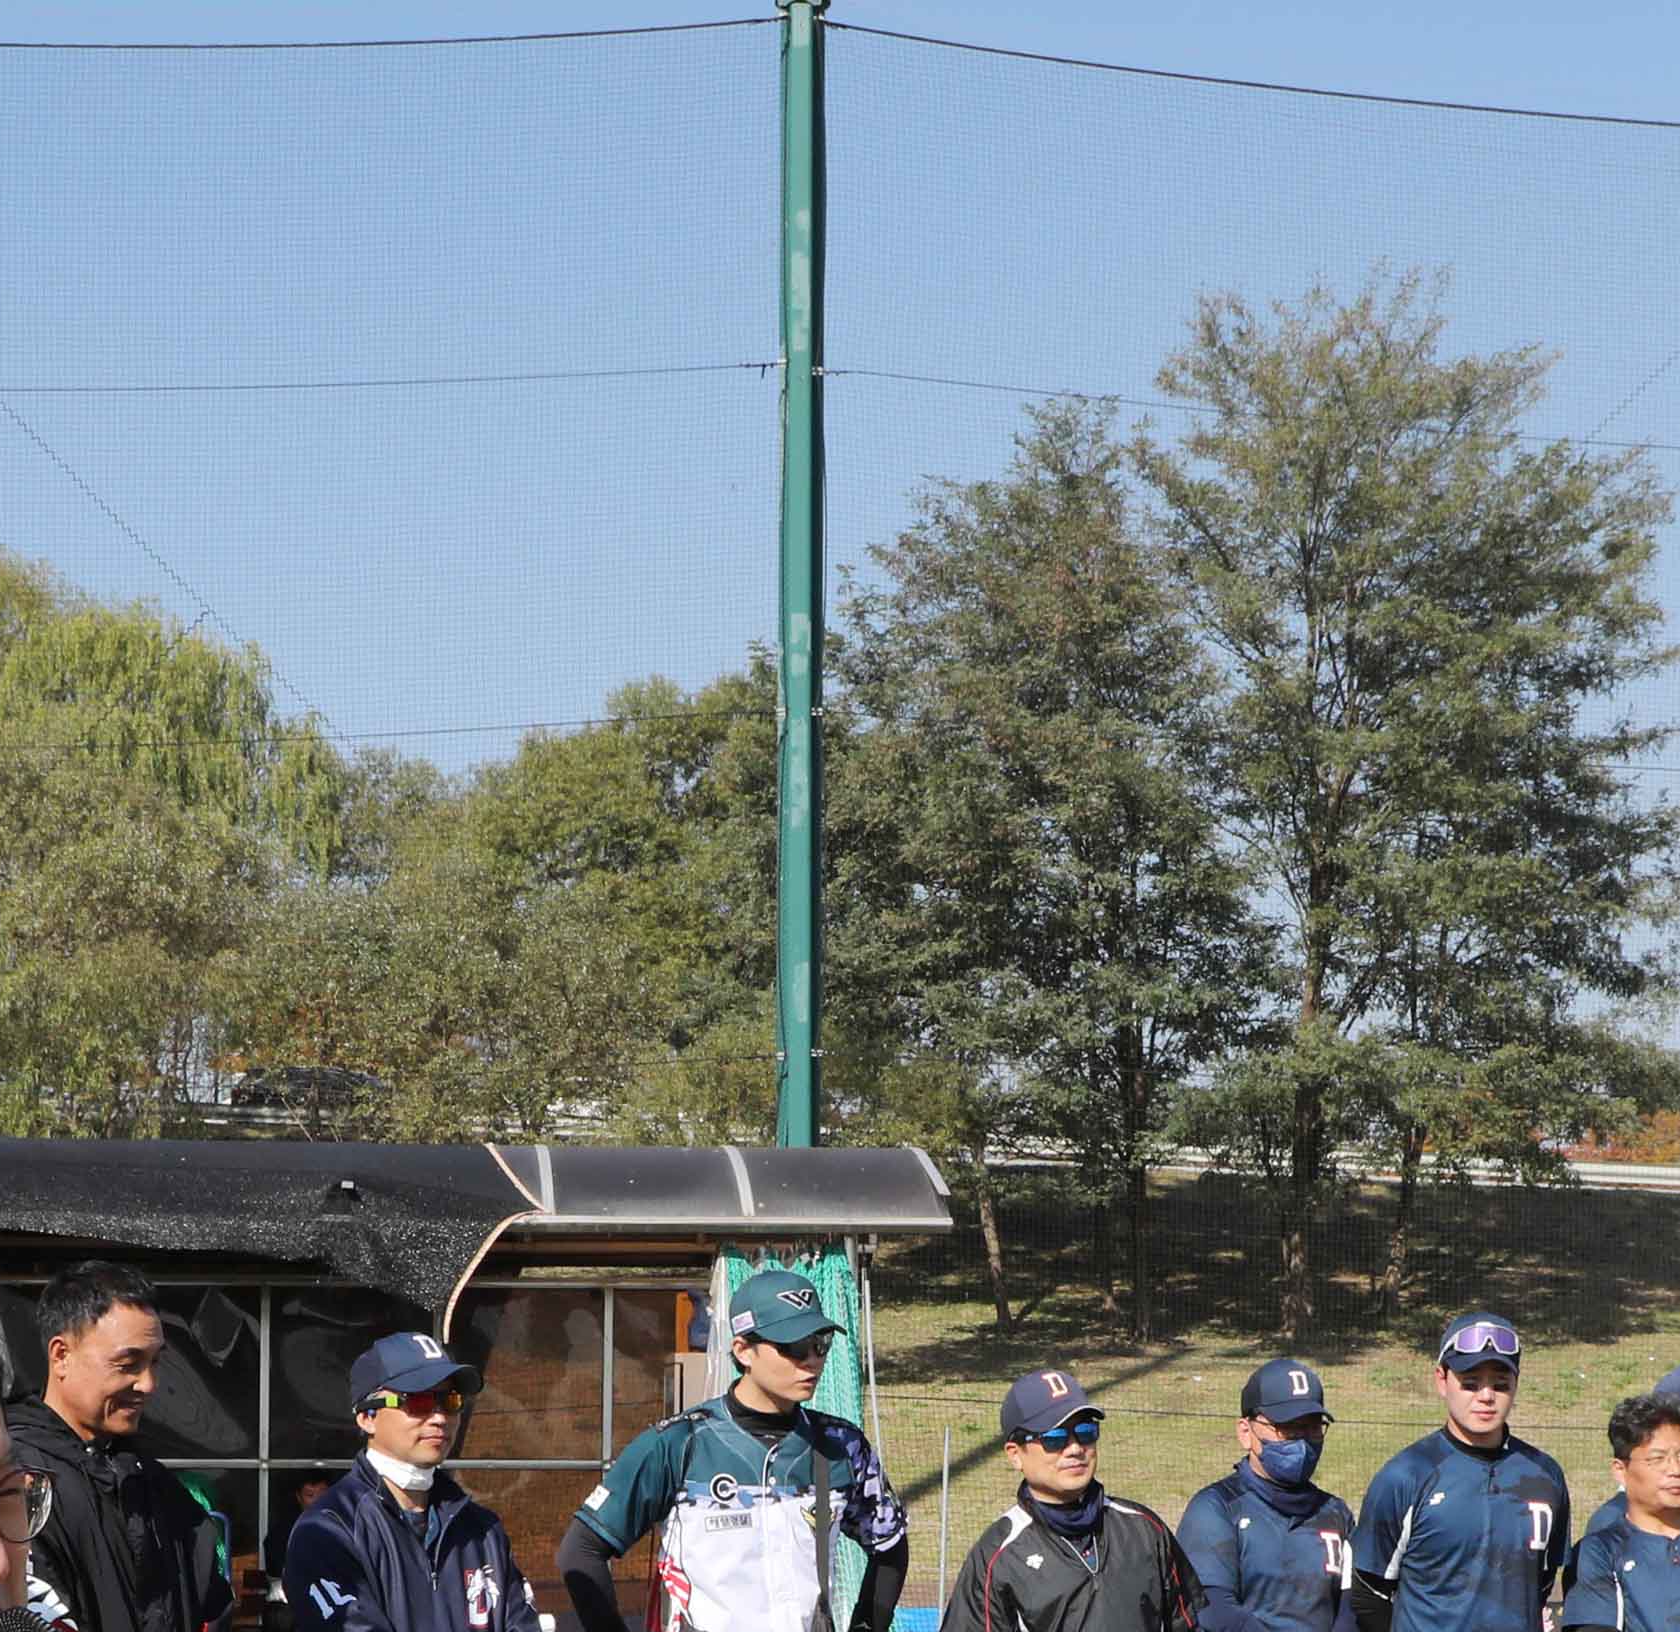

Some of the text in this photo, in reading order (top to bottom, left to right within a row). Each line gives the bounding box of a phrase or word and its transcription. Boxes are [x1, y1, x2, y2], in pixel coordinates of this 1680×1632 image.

[412, 1334, 442, 1359] D
[1041, 1372, 1068, 1399] D
[1287, 1370, 1310, 1395] D
[710, 1473, 738, 1503] C
[1528, 1502, 1553, 1550] D
[1319, 1531, 1342, 1575] D
